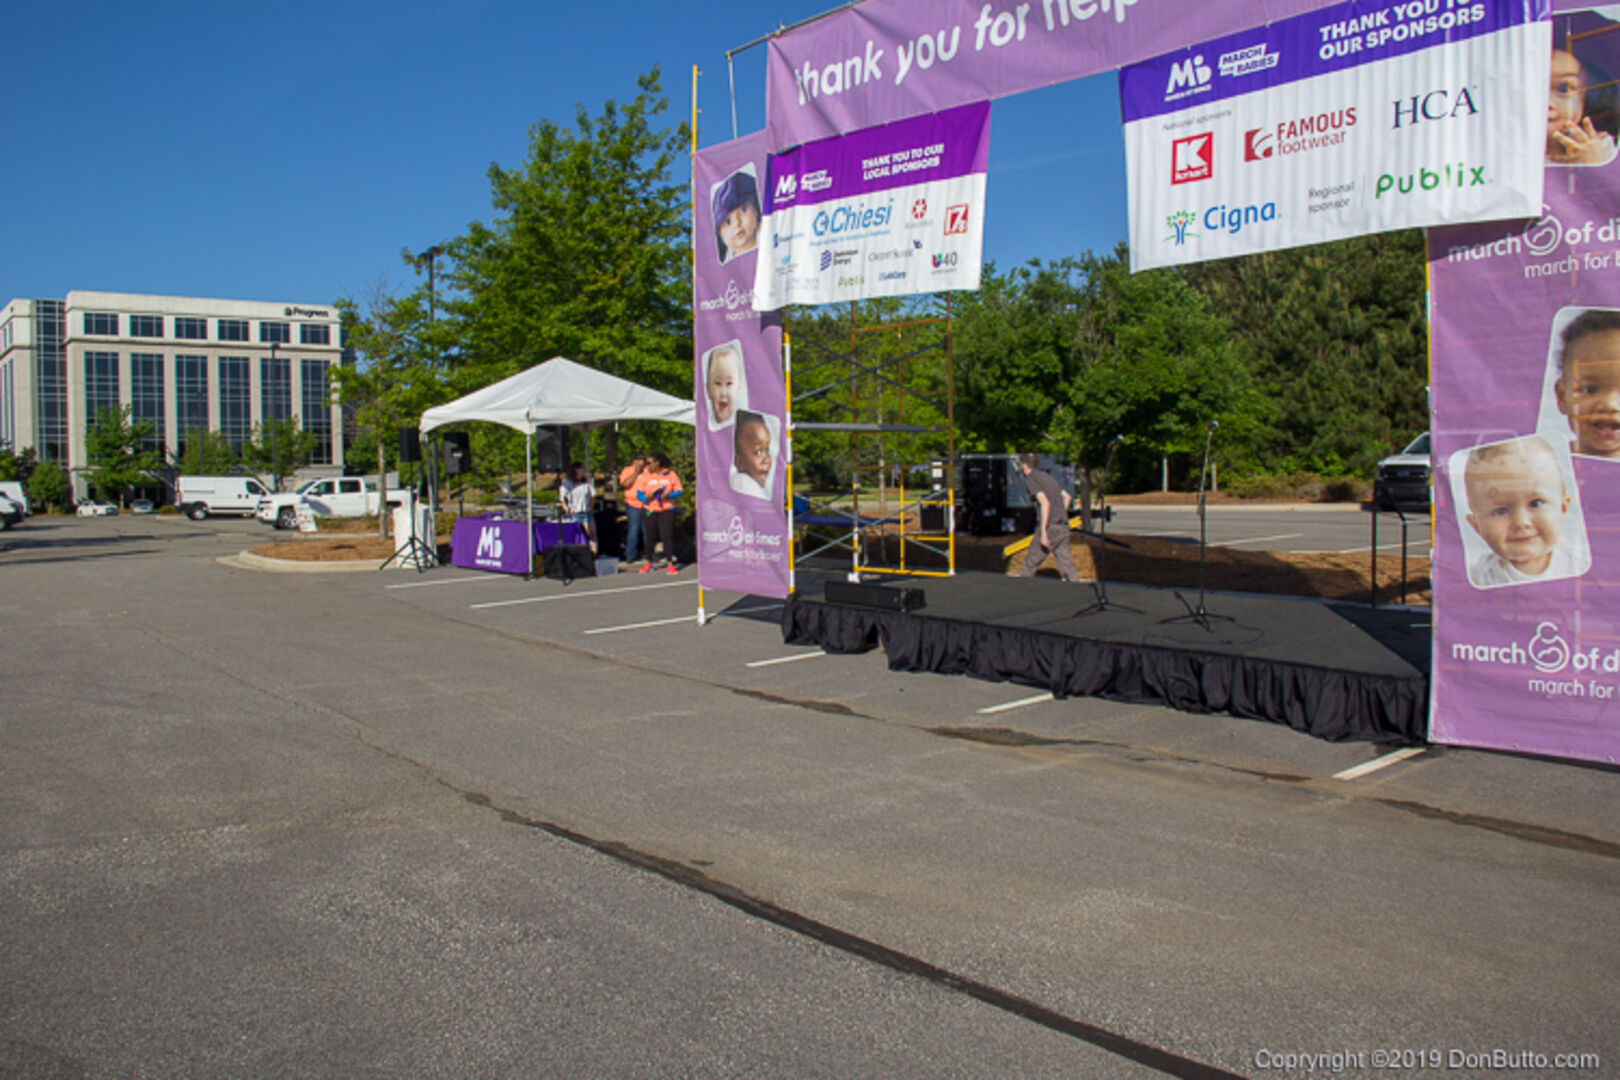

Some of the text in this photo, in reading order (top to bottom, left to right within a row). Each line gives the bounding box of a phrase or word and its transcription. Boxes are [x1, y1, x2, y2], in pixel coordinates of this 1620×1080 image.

[1319, 0, 1439, 42] THANK YOU
[1319, 4, 1485, 60] OUR SPONSORS
[795, 40, 884, 106] thank
[894, 25, 960, 86] you
[974, 3, 1030, 51] for
[1277, 106, 1357, 141] FAMOUS
[1391, 86, 1479, 129] HCA
[862, 143, 944, 170] THANK YOU TO OUR
[1278, 131, 1346, 156] footwear
[863, 156, 940, 181] LOCAL SPONSORS
[1376, 162, 1486, 199] Publix
[1308, 181, 1356, 199] Regional
[1308, 198, 1351, 214] sponsor
[831, 198, 894, 233] Chiesi
[1204, 201, 1276, 234] Cigna
[1448, 233, 1522, 263] march
[1564, 220, 1593, 245] of
[1524, 255, 1579, 278] march
[1584, 252, 1610, 271] for
[1452, 641, 1526, 665] march
[1572, 647, 1600, 670] of
[1528, 678, 1614, 698] march for
